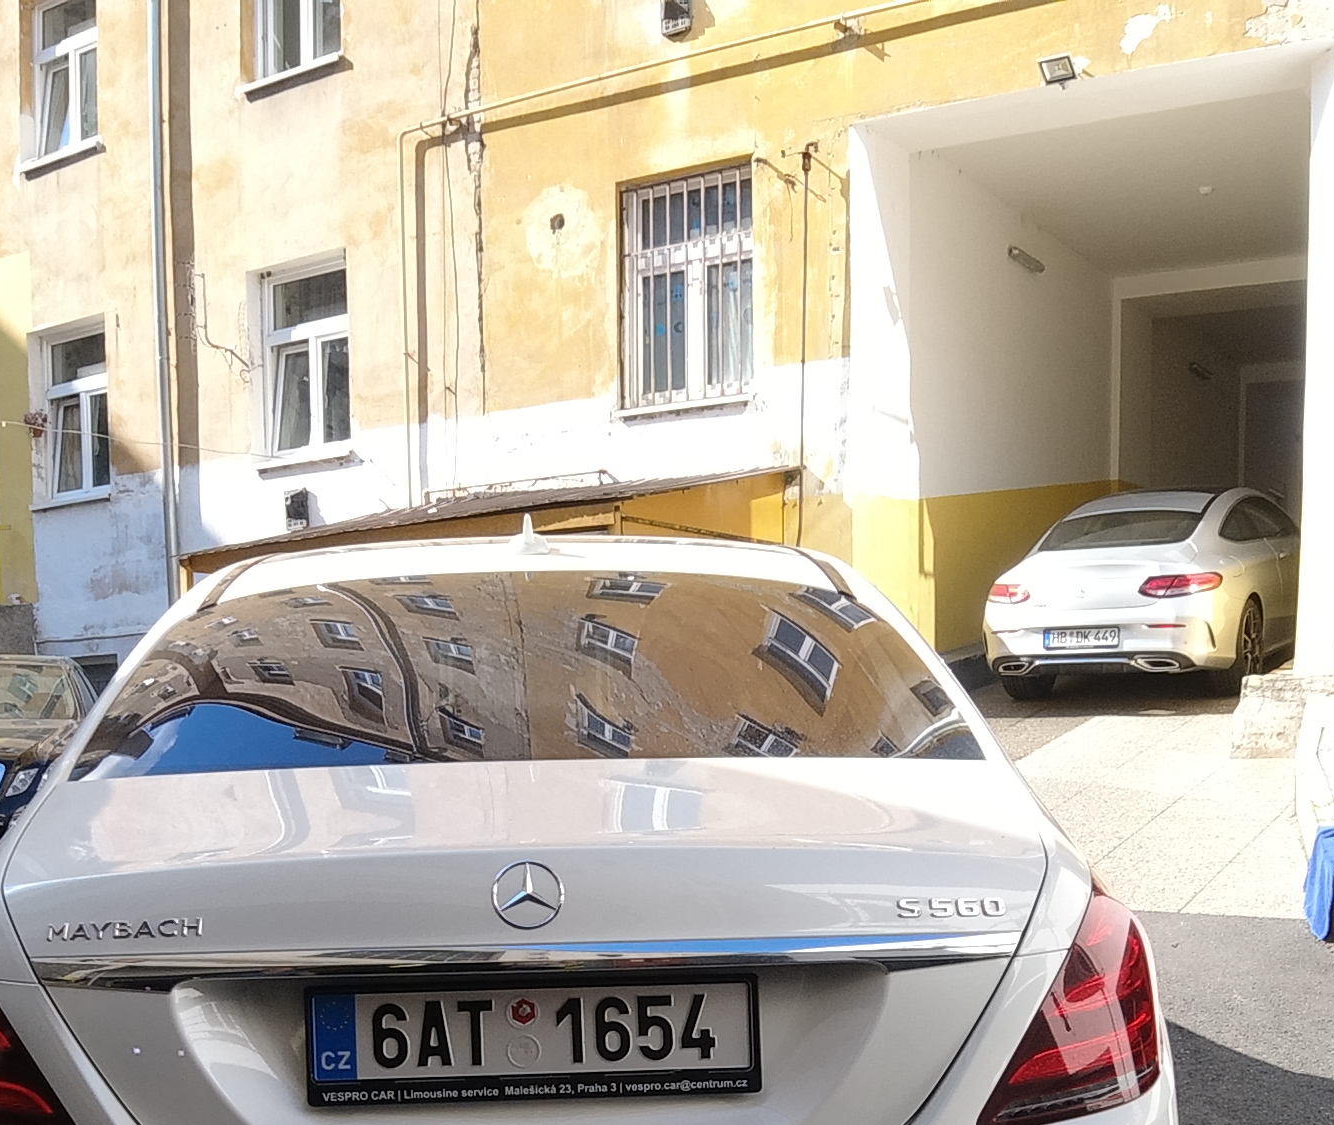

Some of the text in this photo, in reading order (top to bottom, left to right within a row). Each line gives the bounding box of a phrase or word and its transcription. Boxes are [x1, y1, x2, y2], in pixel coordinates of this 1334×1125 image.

[1051, 629, 1117, 644] HB DK 449
[896, 896, 1007, 919] S 560
[45, 917, 204, 942] MAYBACH
[371, 994, 719, 1069] 6AT 1654
[321, 1050, 353, 1071] CZ
[322, 1091, 369, 1103] VESPRO
[370, 1090, 395, 1101] CAR
[403, 1088, 459, 1100] Limousine
[460, 1087, 500, 1098] service
[558, 1083, 575, 1095] 23,
[577, 1082, 608, 1094] Praha
[610, 1082, 617, 1093] 3
[625, 1078, 749, 1094] vespro.car@centrum.cz
